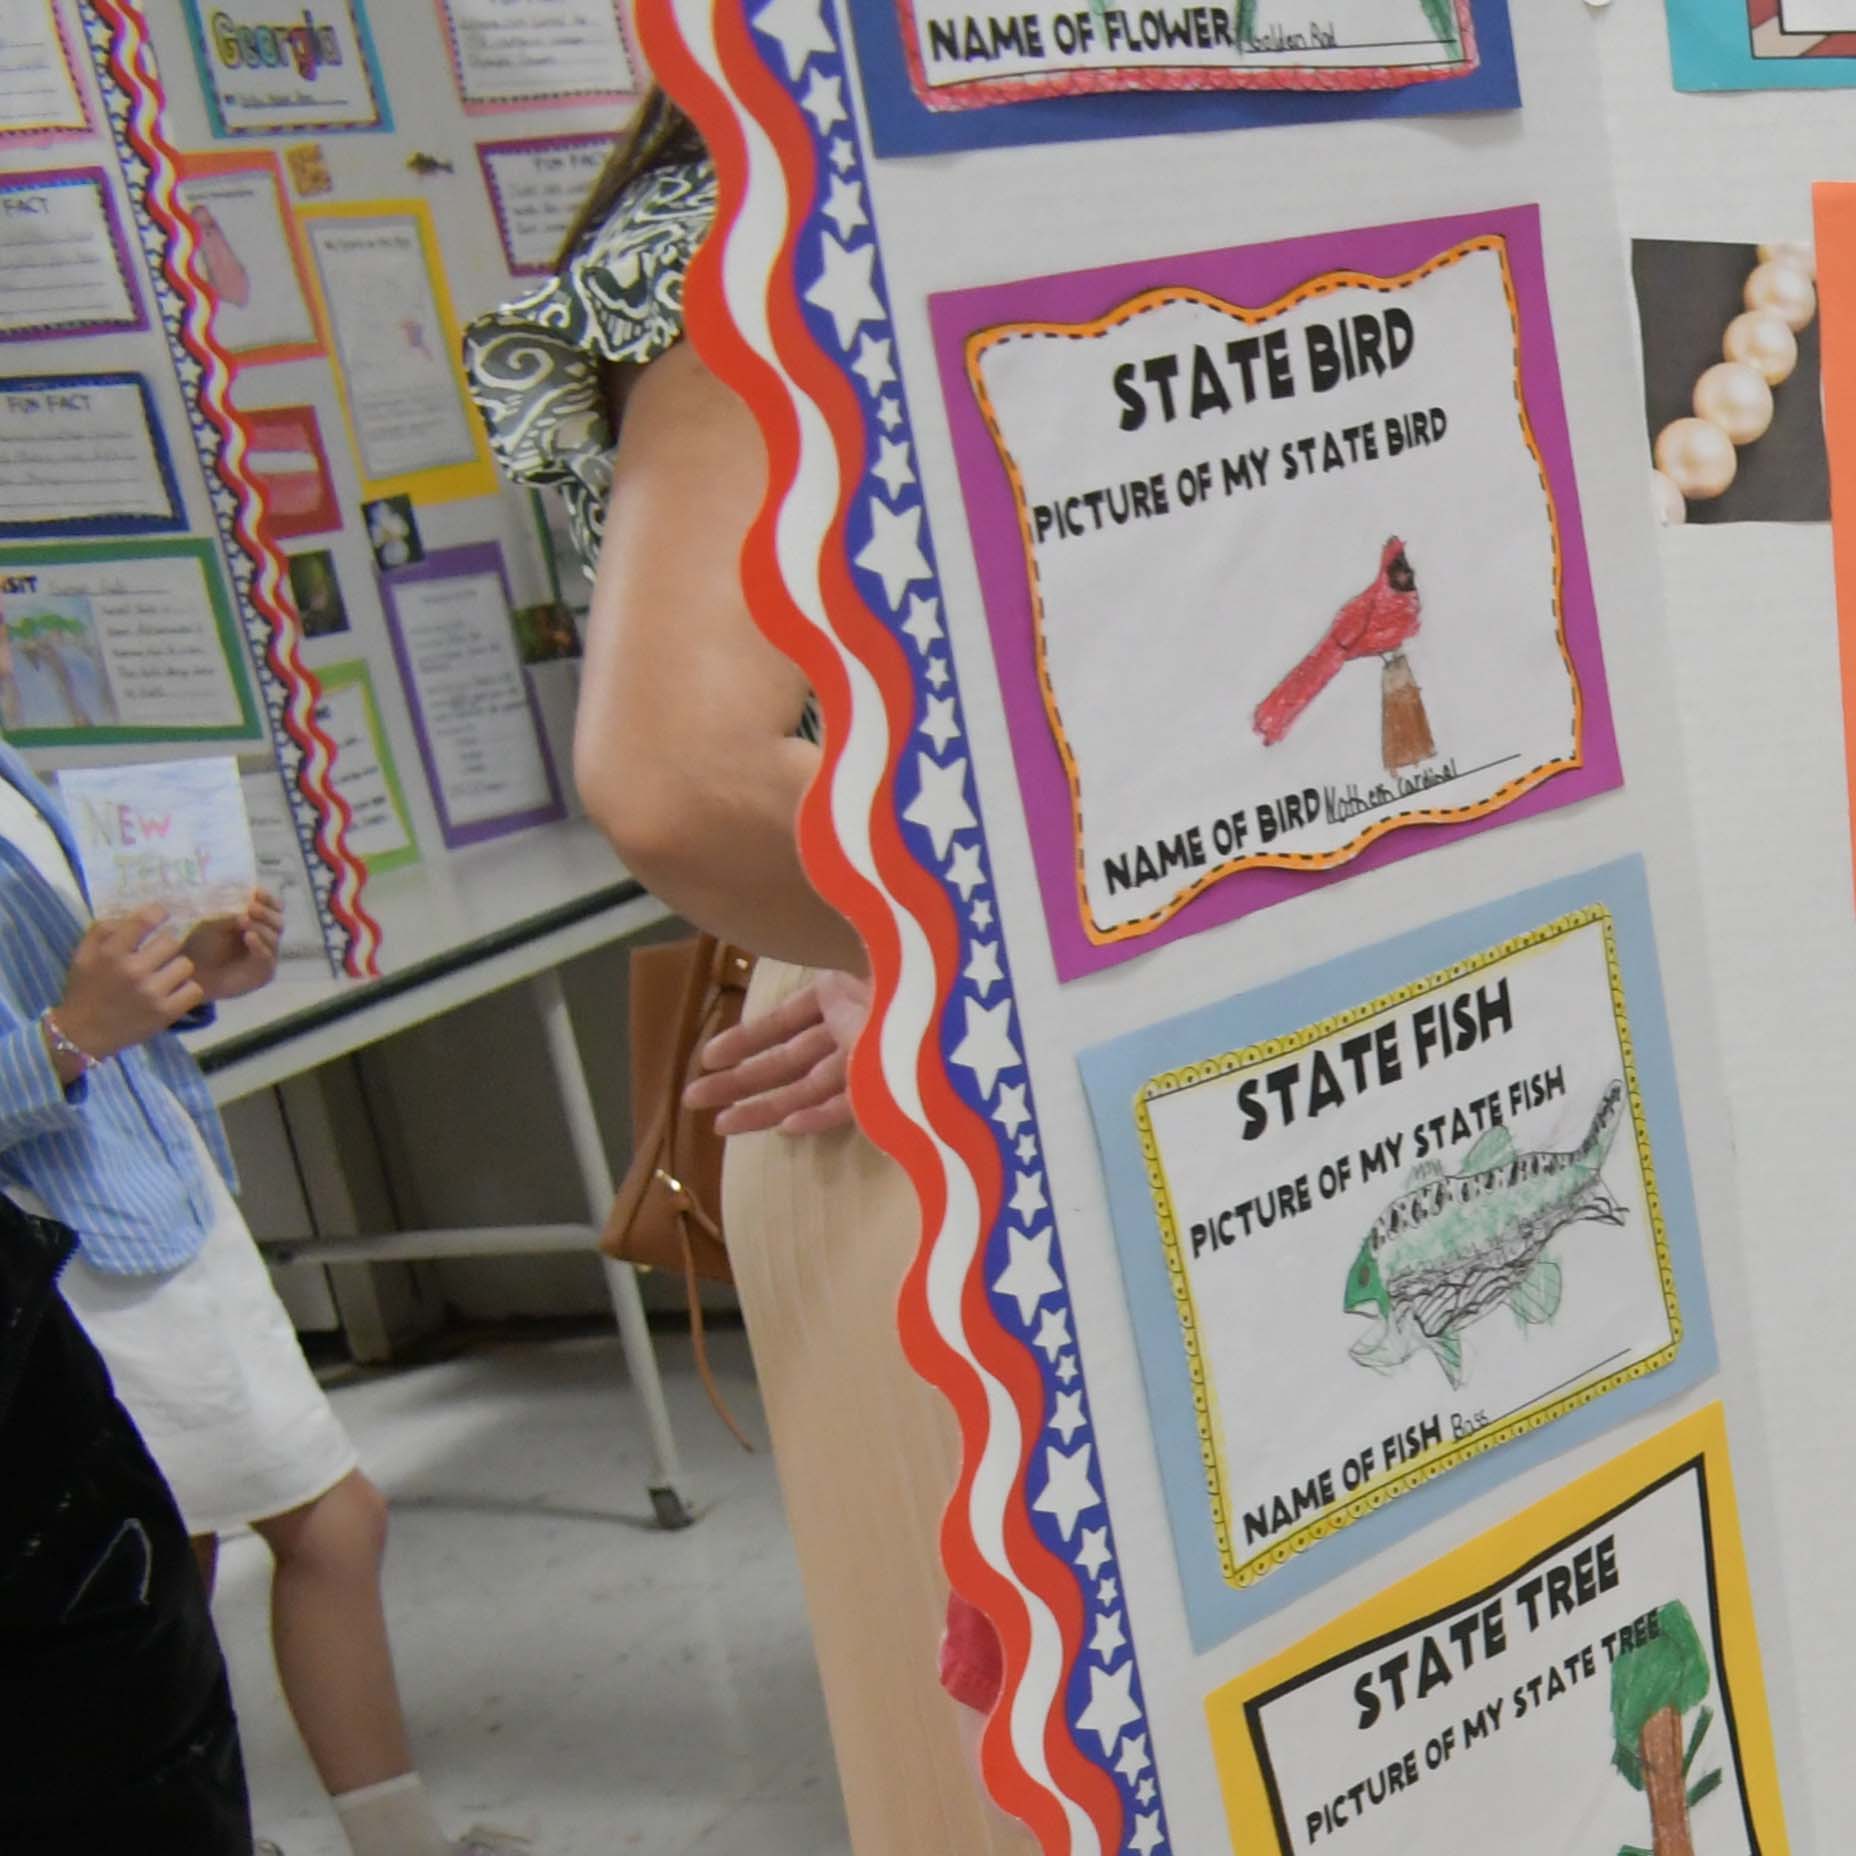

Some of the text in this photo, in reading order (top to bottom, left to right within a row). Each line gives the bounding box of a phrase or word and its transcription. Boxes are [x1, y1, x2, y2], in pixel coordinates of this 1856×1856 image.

[928, 7, 1233, 62] NAME OF FLOWER
[1112, 307, 1415, 432] STATE BIRD
[1033, 406, 1448, 544] PICTURE OF MY STATE BIRD
[1103, 786, 1322, 896] NAME OF BIRD
[1238, 976, 1514, 1141] STATE FISH
[1189, 1064, 1566, 1261] PICTURE OF MY STATE FISH
[1242, 1413, 1443, 1546] NAME OF FISH
[1449, 1409, 1490, 1442] Bass
[1353, 1533, 1620, 1731] STATE TREE
[1306, 1606, 1664, 1846] PICTURE OF MY STATE TREE
